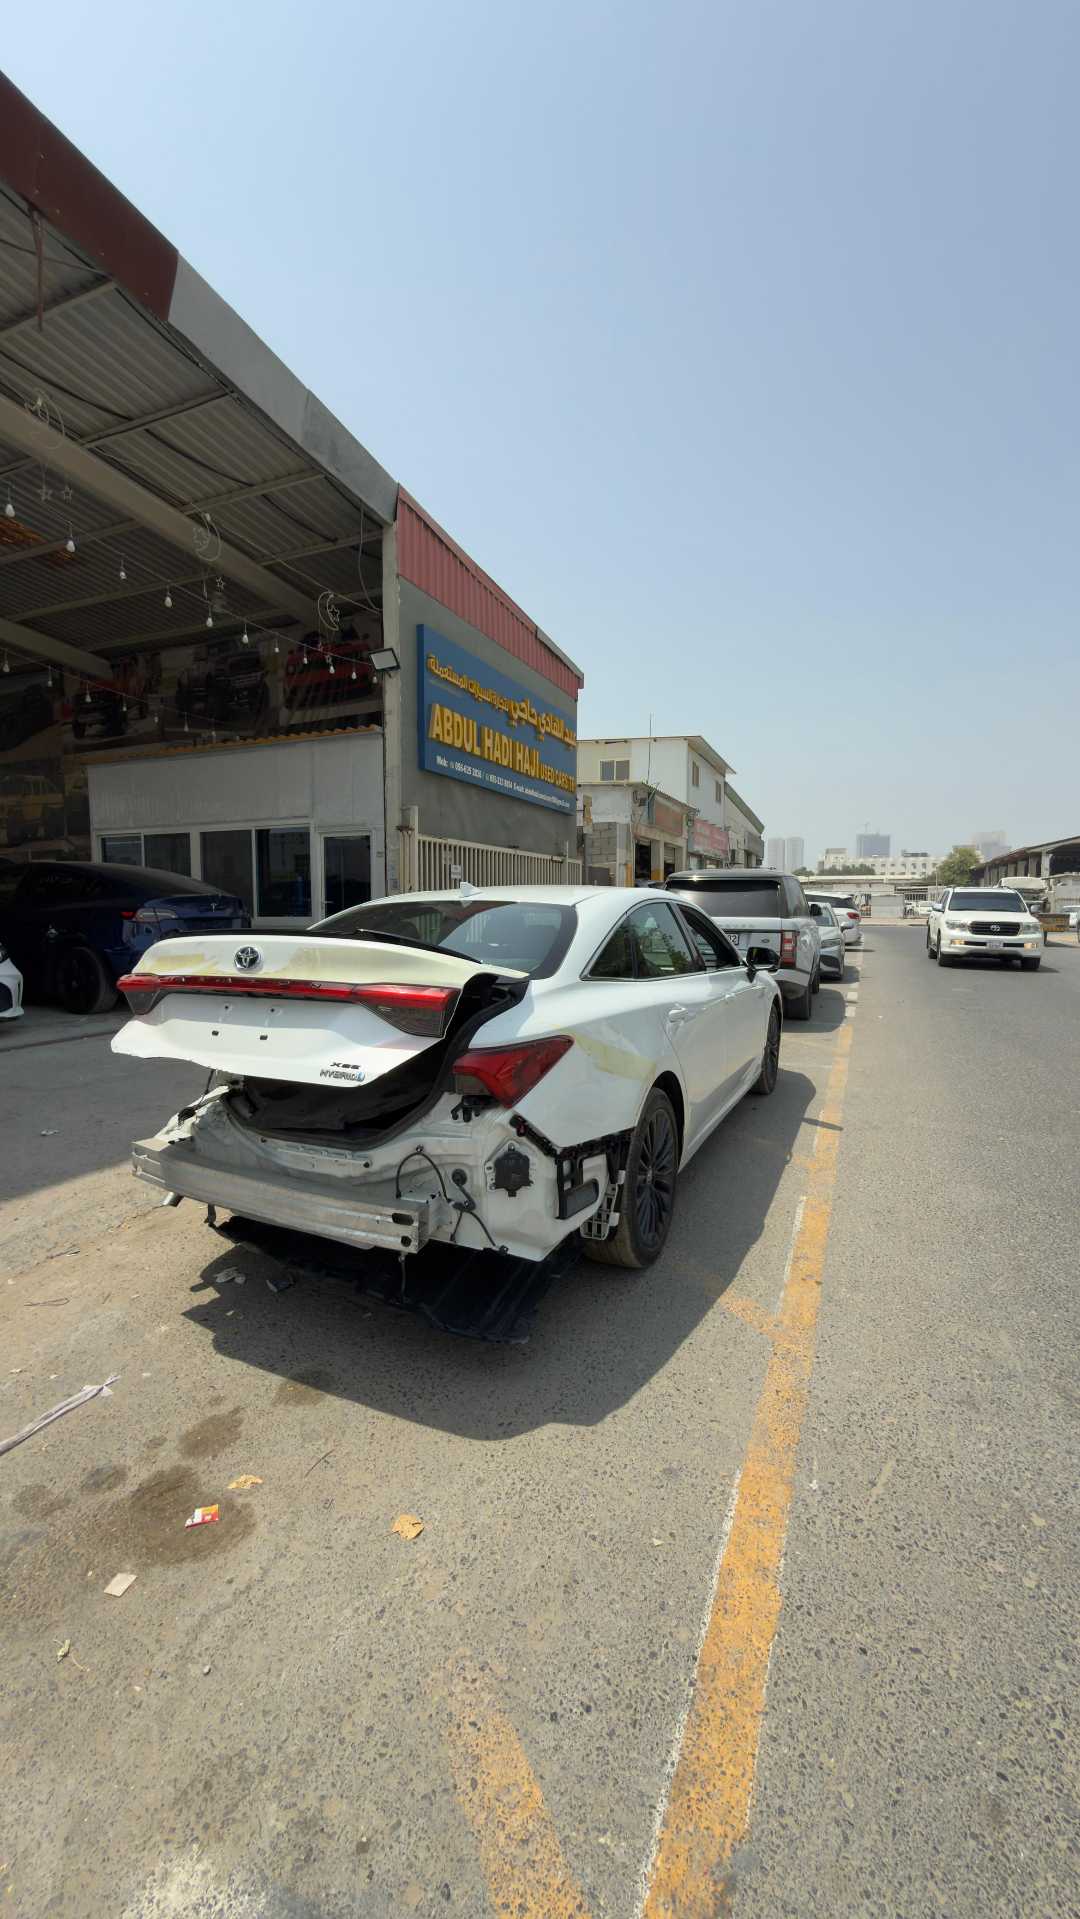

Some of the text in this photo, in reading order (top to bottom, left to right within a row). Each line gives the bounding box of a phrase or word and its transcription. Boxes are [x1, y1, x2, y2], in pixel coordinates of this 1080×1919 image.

[429, 703, 481, 756] ABDUL
[481, 724, 513, 769] HADI
[514, 740, 541, 779] HAJI
[540, 763, 554, 784] USED
[319, 1069, 357, 1082] HYBRID
